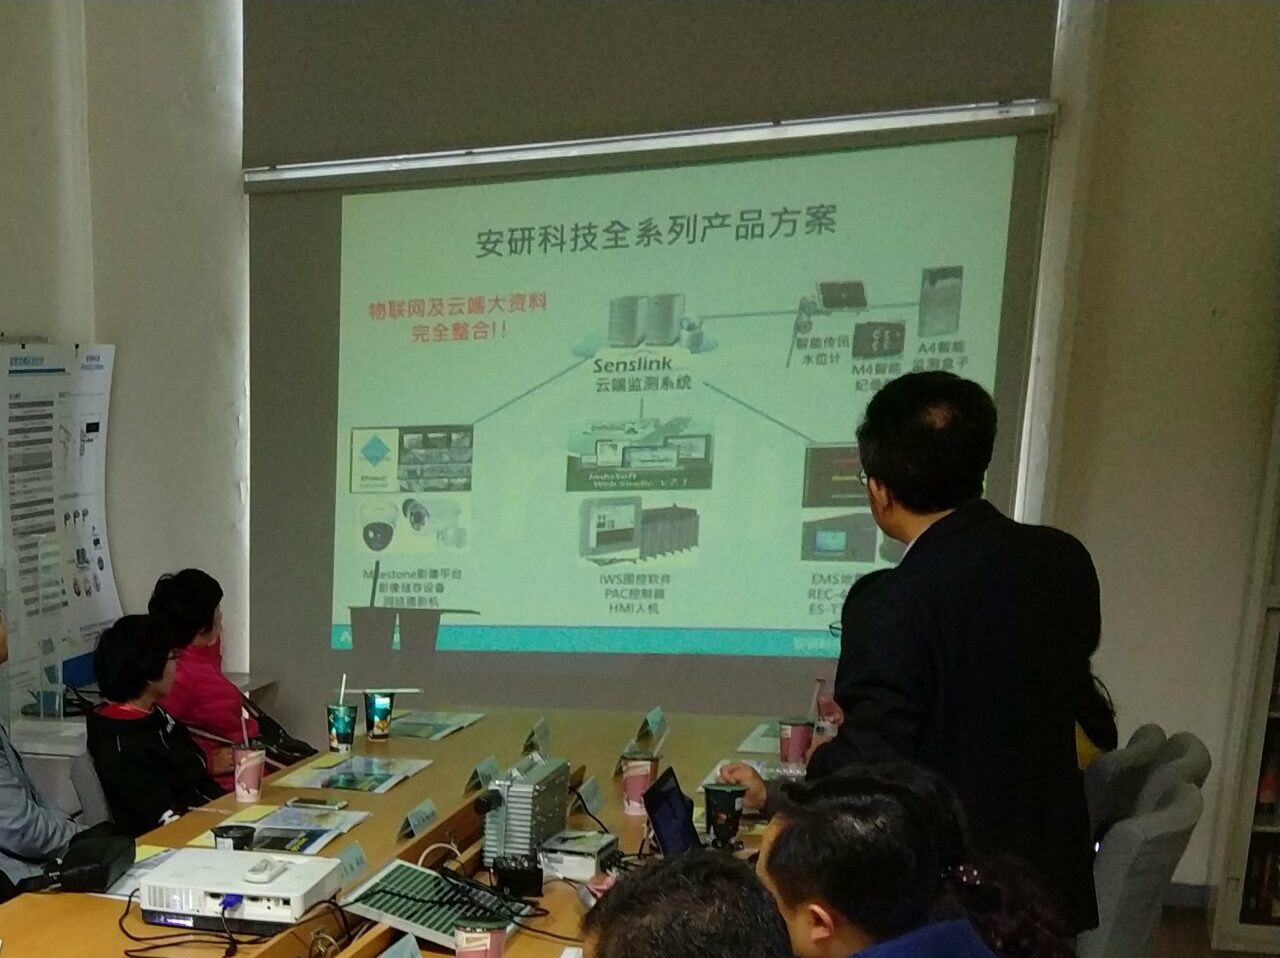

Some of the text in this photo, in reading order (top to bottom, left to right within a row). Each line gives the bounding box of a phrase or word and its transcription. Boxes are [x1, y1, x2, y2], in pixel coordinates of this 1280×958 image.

[476, 203, 838, 259] 安研科技全系列产品方案
[368, 291, 548, 321] 物联网及云端大资料
[593, 356, 673, 374] Senslink
